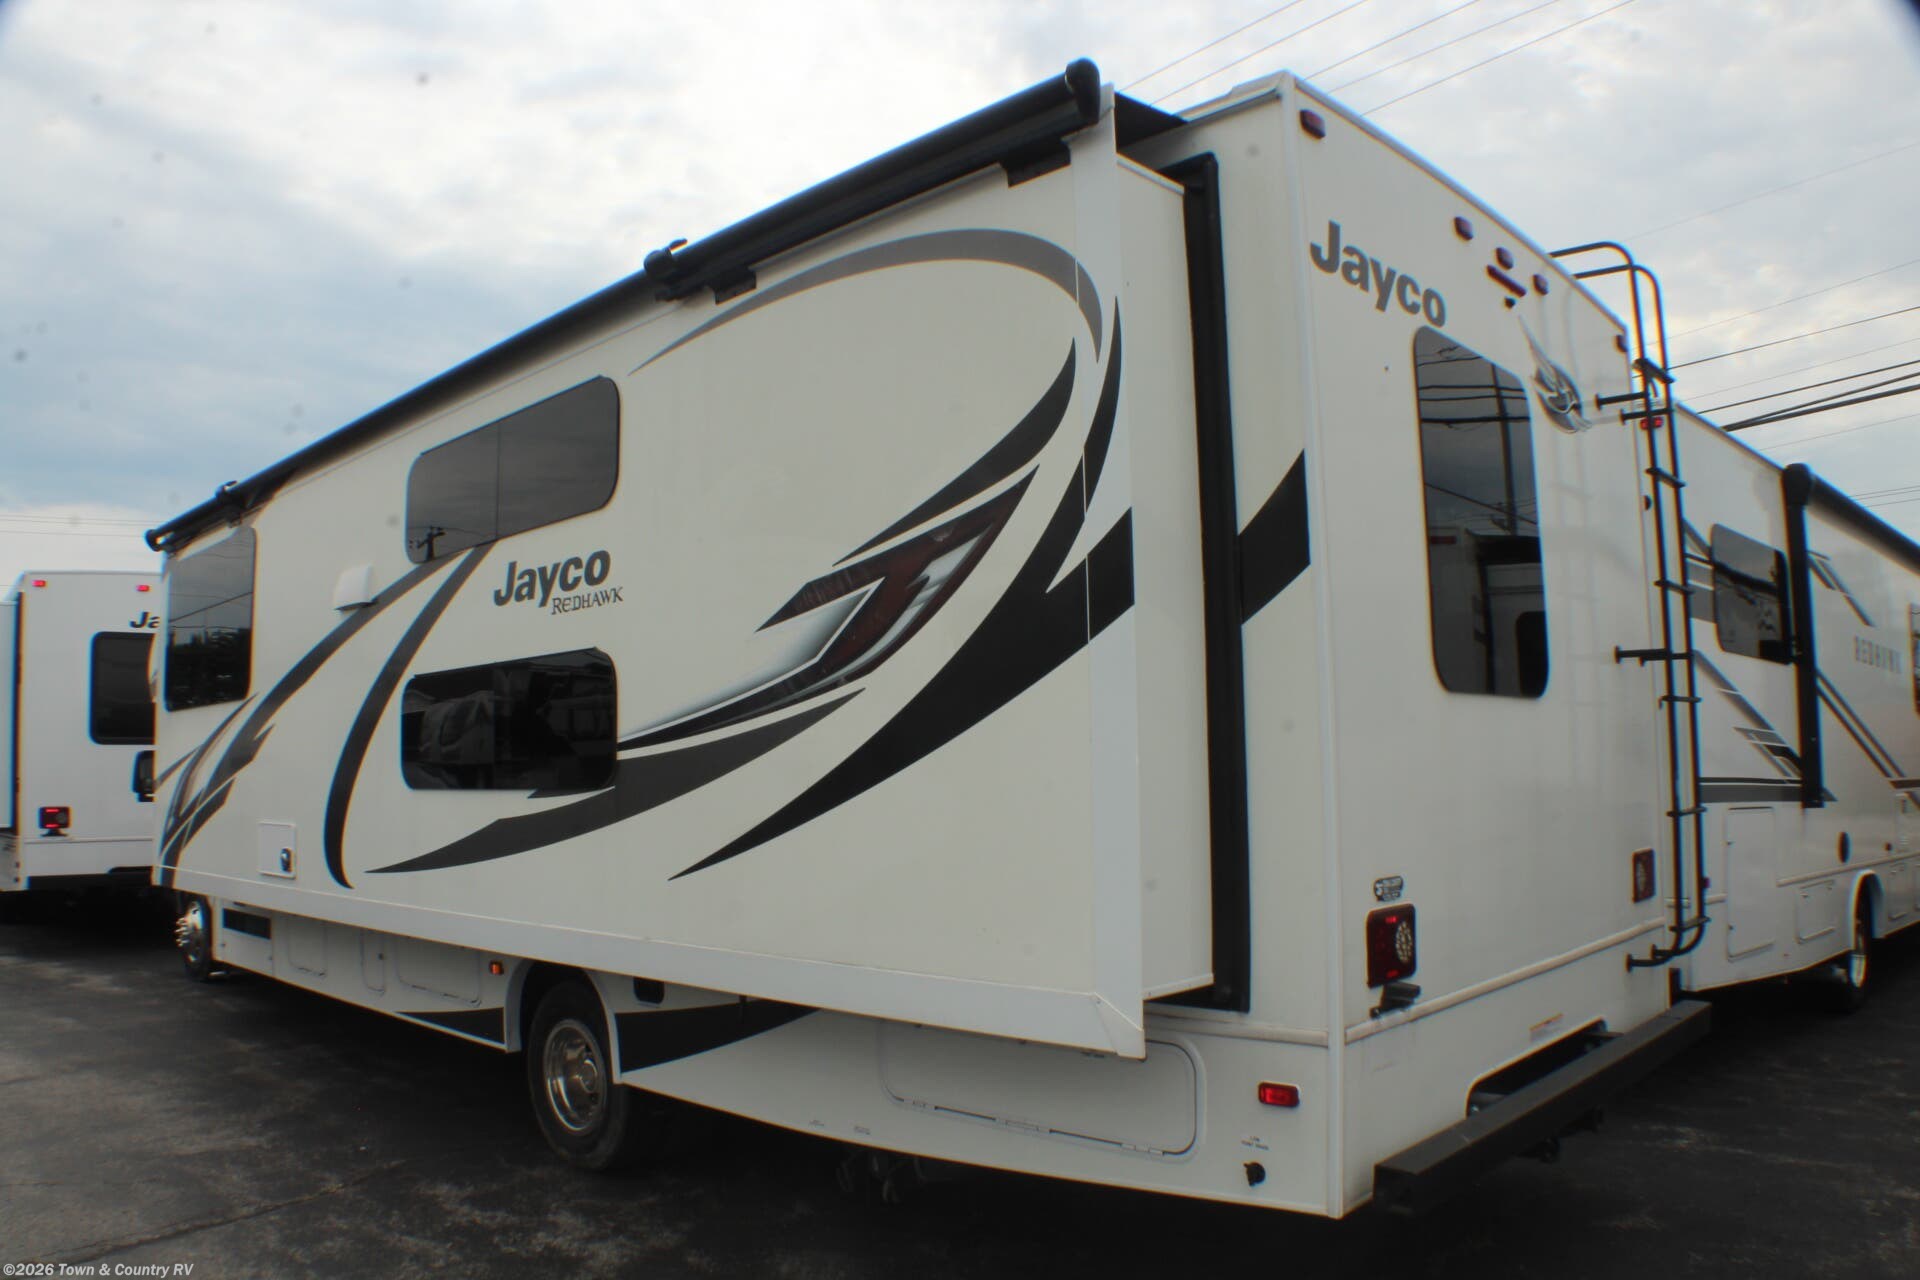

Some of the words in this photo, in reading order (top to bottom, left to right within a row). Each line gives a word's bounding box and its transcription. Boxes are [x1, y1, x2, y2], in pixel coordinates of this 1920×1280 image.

[1309, 219, 1446, 328] Jayco
[493, 549, 611, 608] Jayco
[551, 586, 624, 615] REDHAWK
